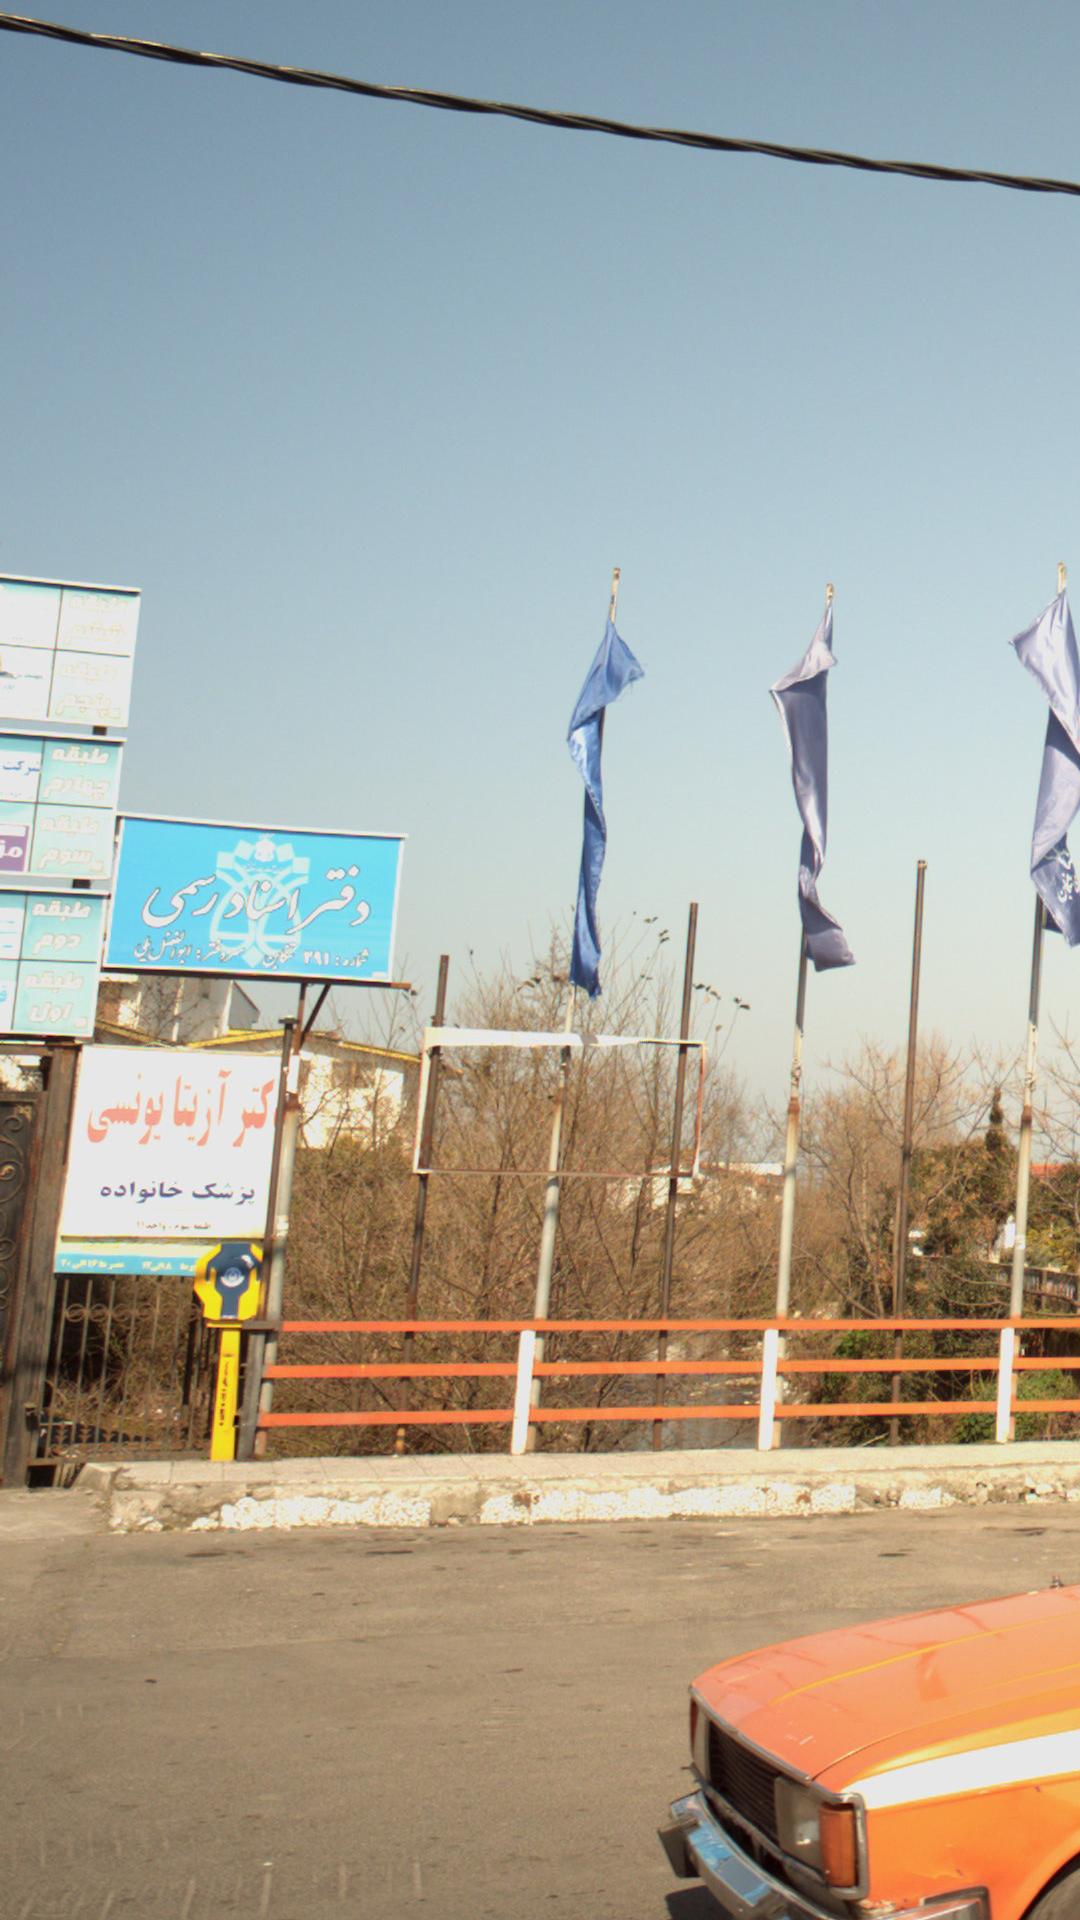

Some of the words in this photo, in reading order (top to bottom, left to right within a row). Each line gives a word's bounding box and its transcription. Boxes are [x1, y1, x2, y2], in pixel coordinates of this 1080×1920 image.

[51, 744, 109, 766] طبقه
[40, 813, 98, 837] طبقه
[141, 874, 218, 928] رسمی
[223, 879, 300, 921] اسناد
[285, 864, 371, 935] دفتر
[31, 900, 91, 923] طبقه
[33, 933, 81, 955] دوم
[24, 971, 83, 993] طبقه
[29, 1002, 73, 1023] اول
[87, 1073, 164, 1144] یونسی
[173, 1069, 231, 1147] آزیتا
[232, 1077, 277, 1147] کتر
[100, 1180, 183, 1203] خانواده
[191, 1183, 255, 1205] پزشک
